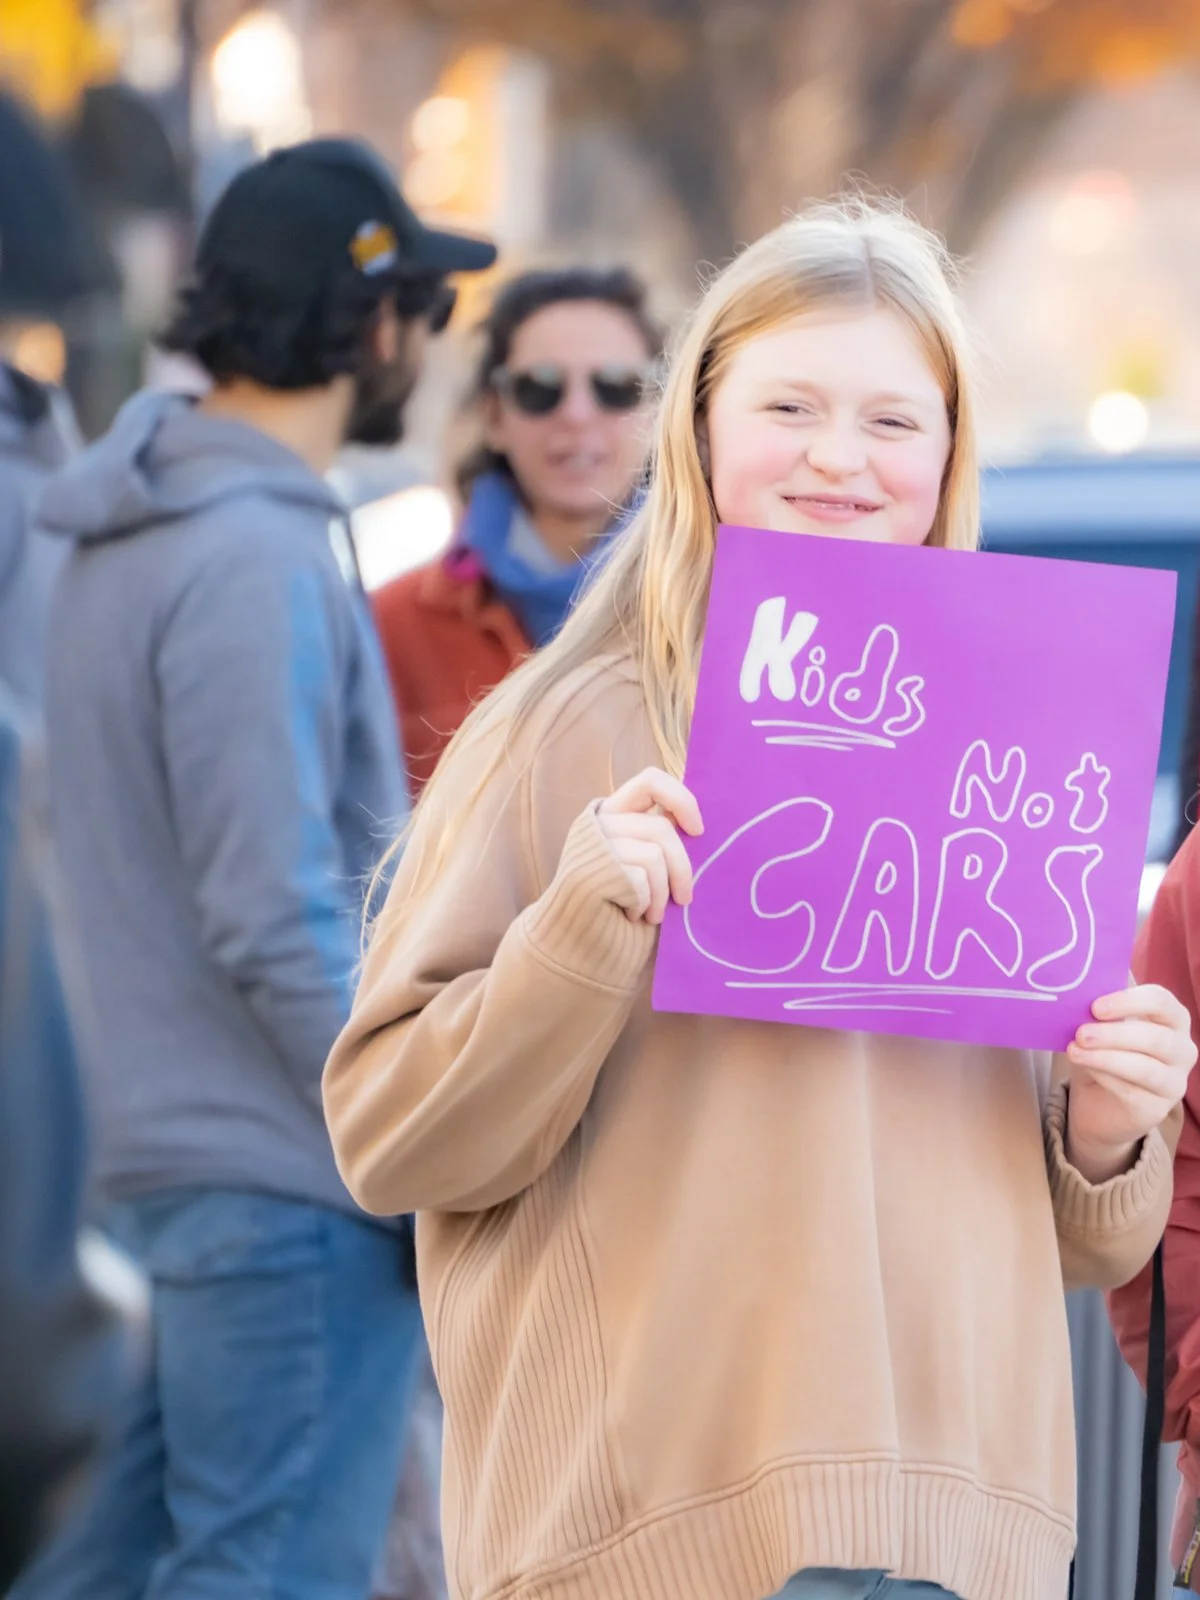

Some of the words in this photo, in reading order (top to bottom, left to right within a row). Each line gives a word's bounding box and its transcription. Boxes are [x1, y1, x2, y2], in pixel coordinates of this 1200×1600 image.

[739, 596, 926, 737] Kids
[949, 739, 1111, 834] Not
[683, 796, 1104, 993] CARS
